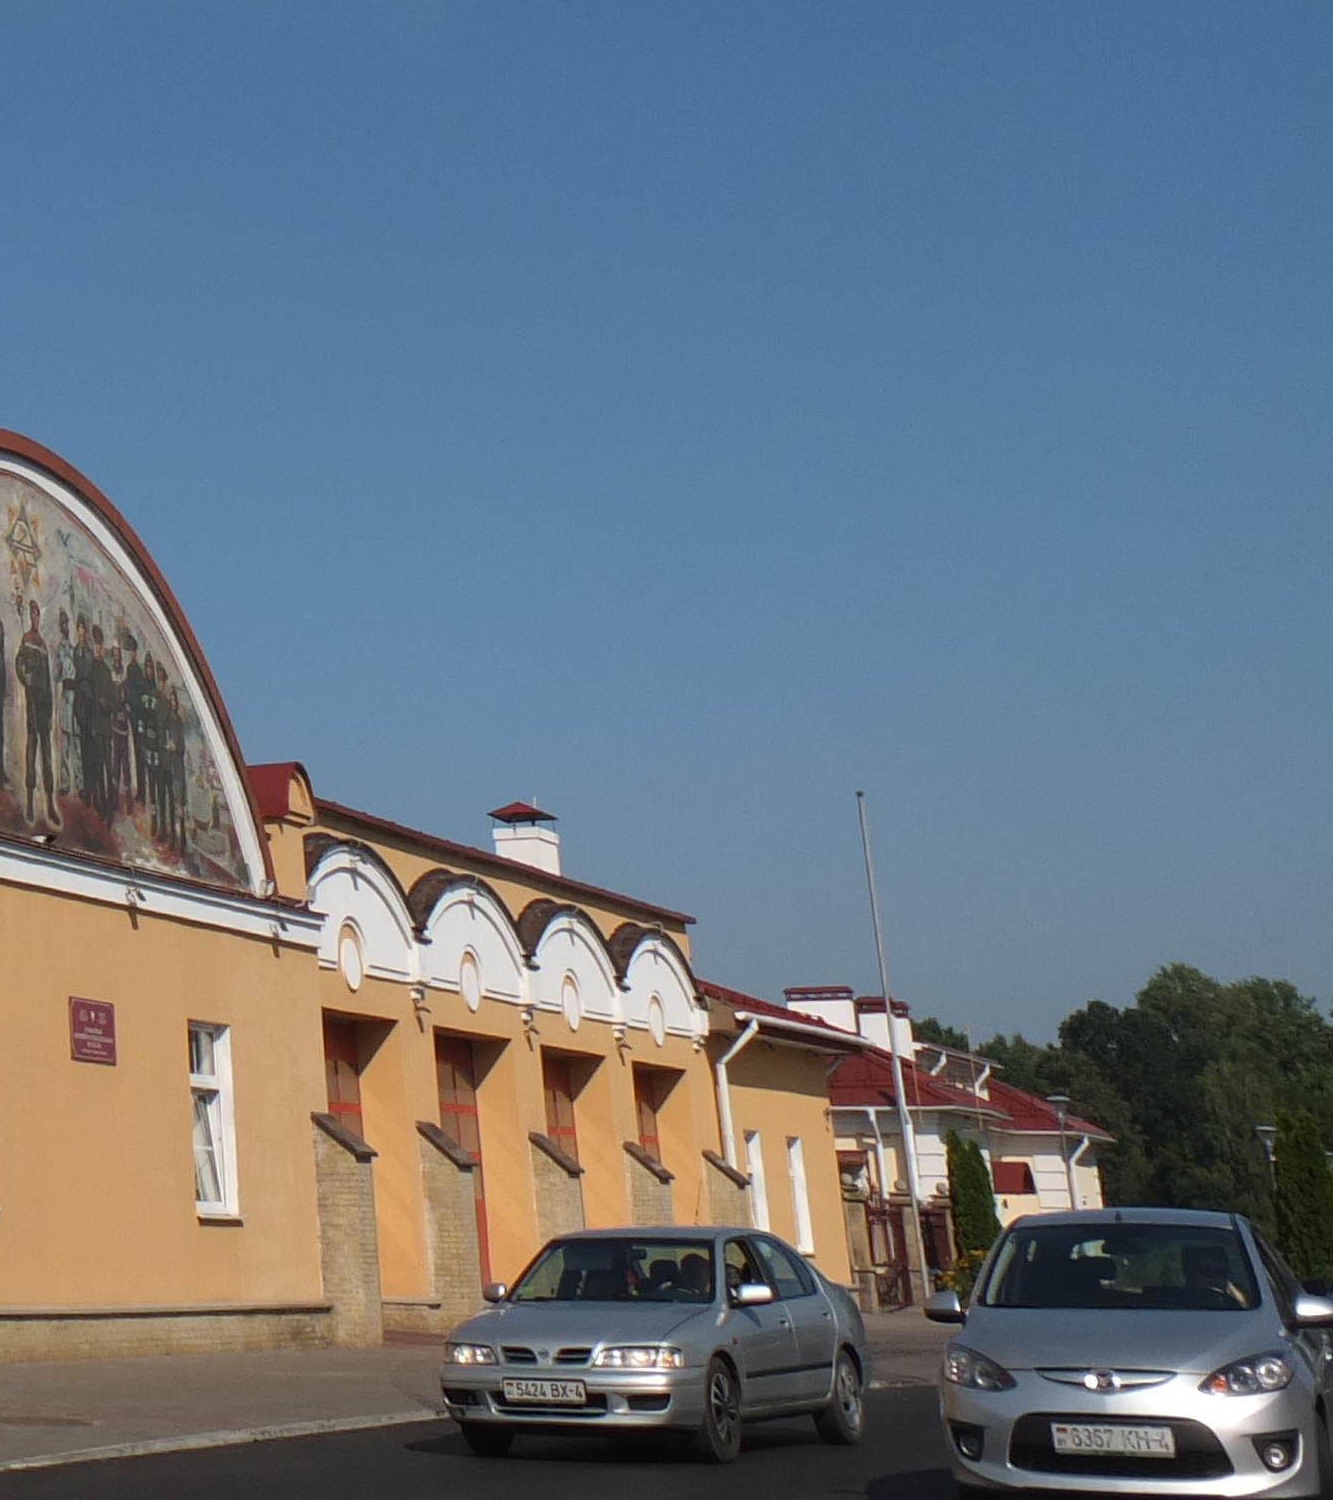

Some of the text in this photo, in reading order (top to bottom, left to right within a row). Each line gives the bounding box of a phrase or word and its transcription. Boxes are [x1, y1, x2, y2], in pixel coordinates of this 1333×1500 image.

[515, 1382, 583, 1399] 5424 BX-4
[1072, 1427, 1170, 1451] 6357 KH-4
